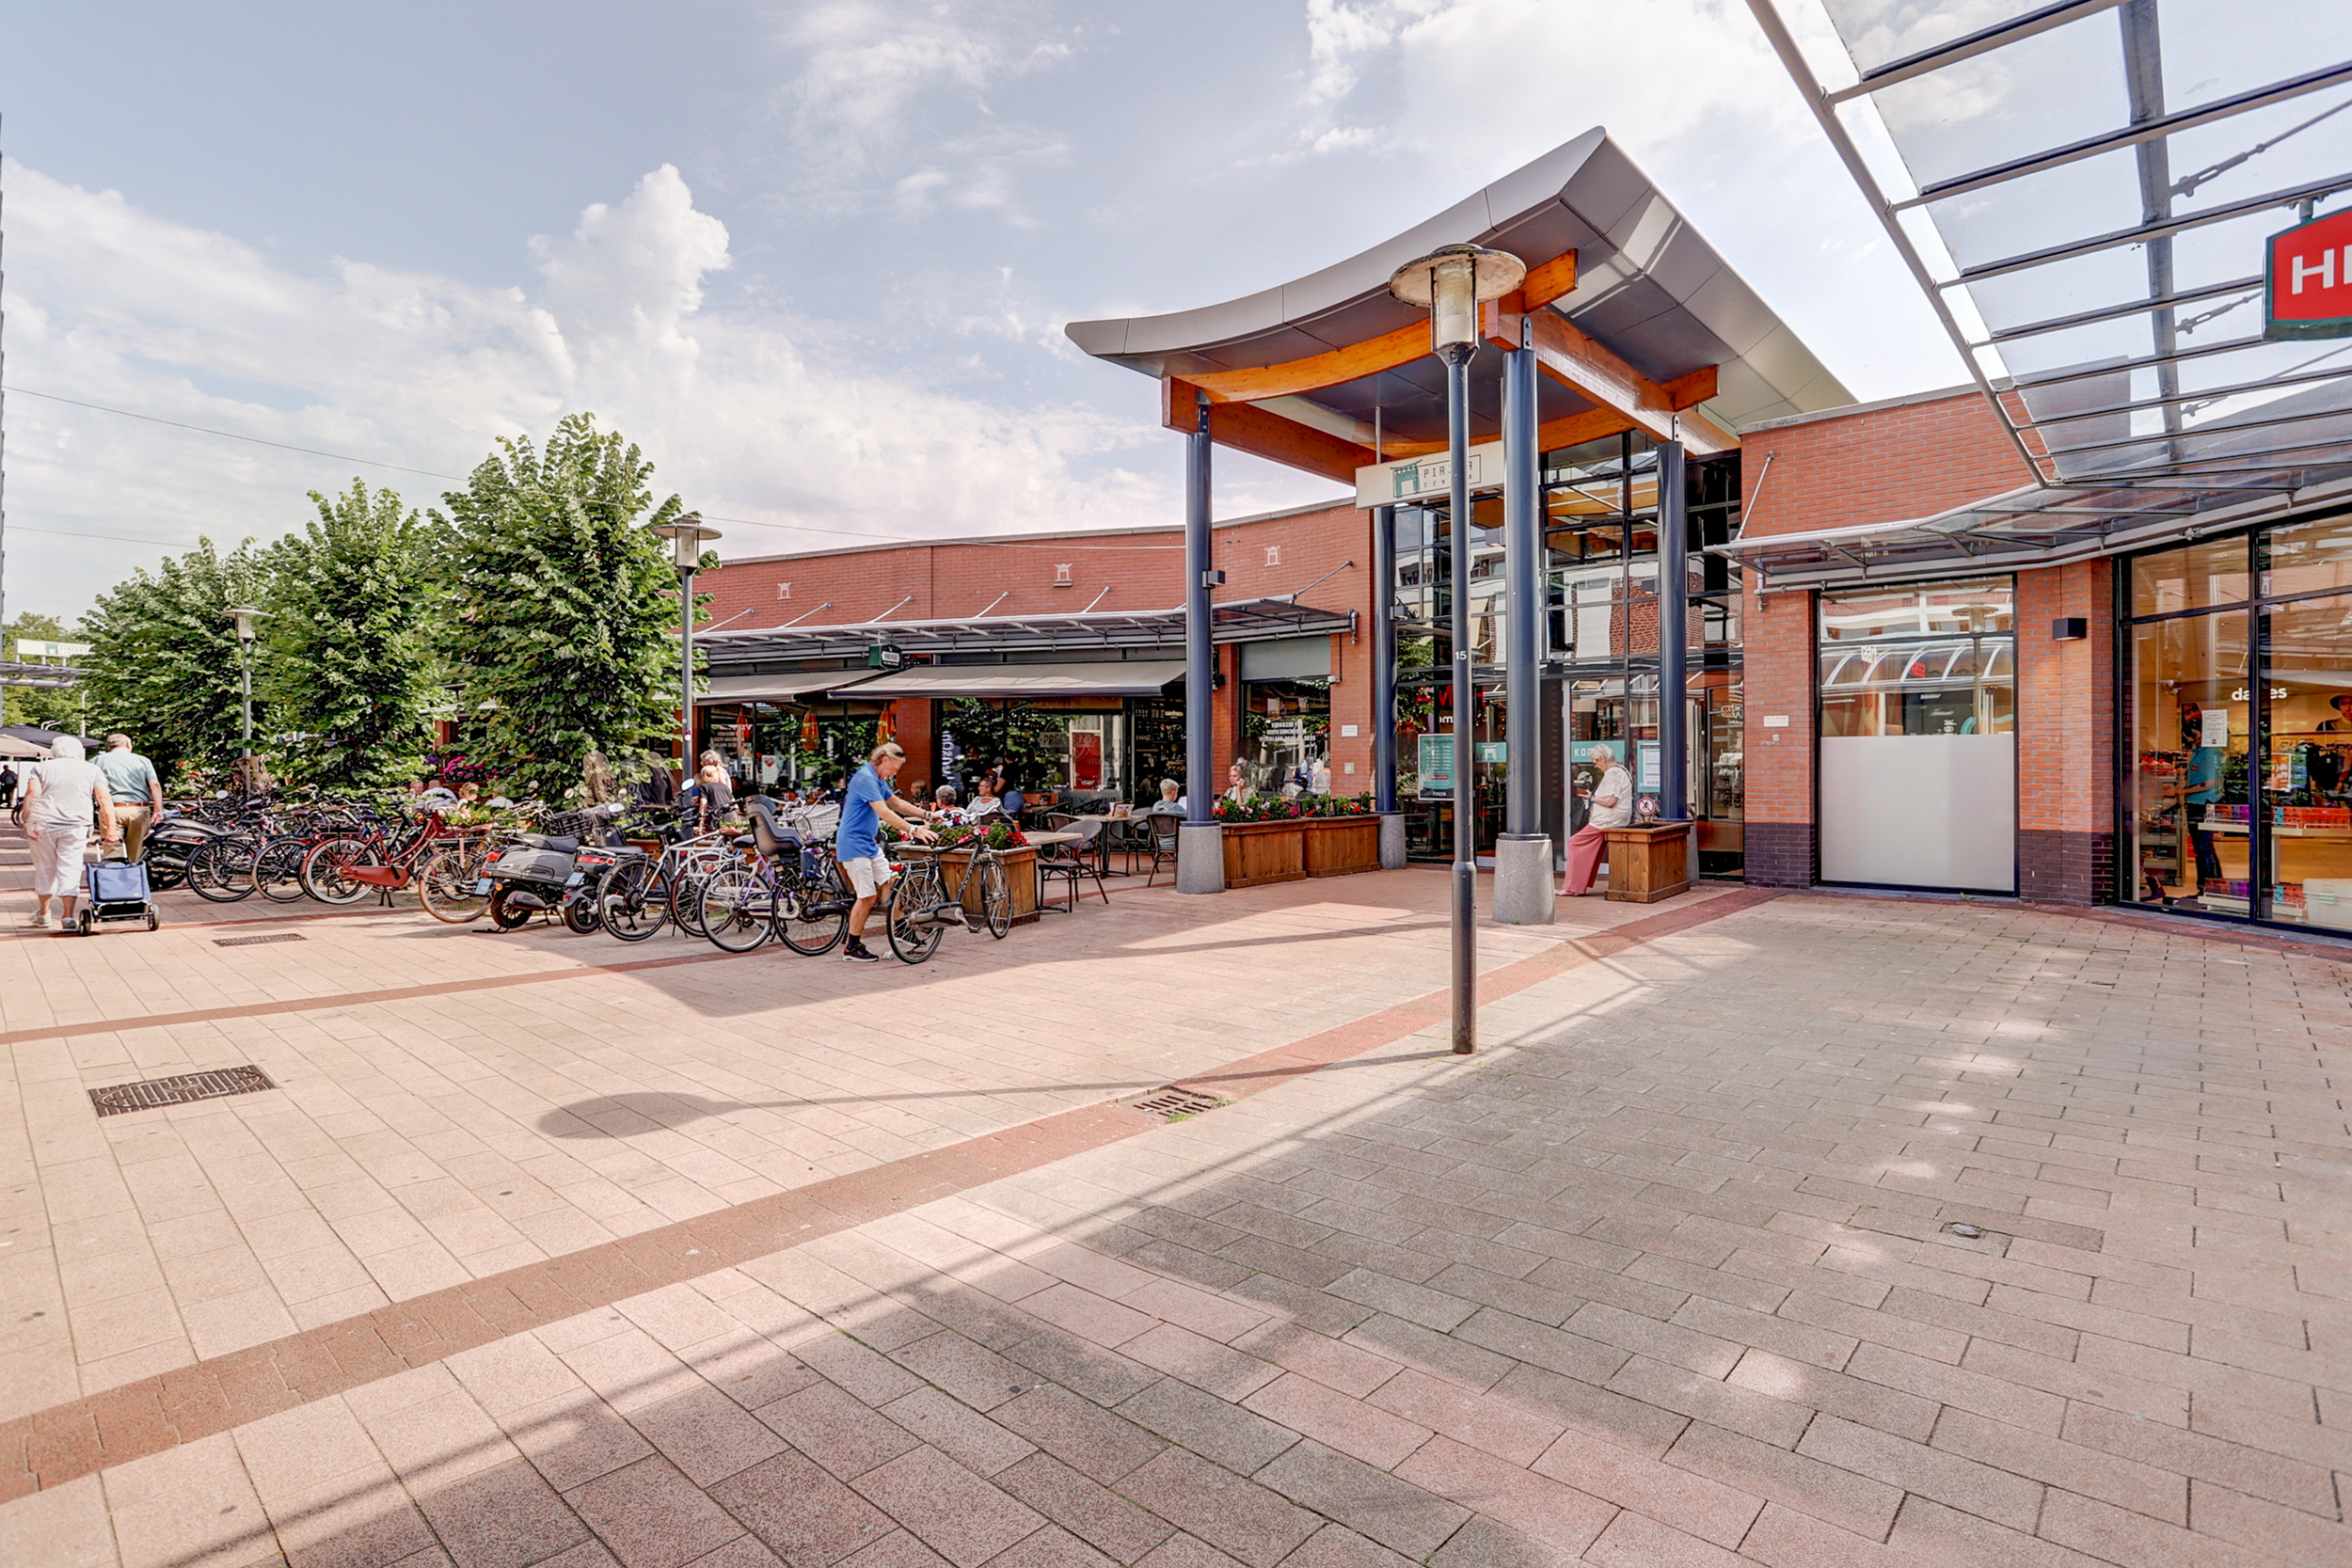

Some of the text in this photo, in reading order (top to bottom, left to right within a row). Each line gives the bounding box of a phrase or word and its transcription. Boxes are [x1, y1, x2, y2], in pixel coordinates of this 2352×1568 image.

[2291, 244, 2352, 295] H
[1423, 461, 1472, 479] PIAA
[1454, 650, 1468, 660] 15
[2231, 686, 2288, 702] daes
